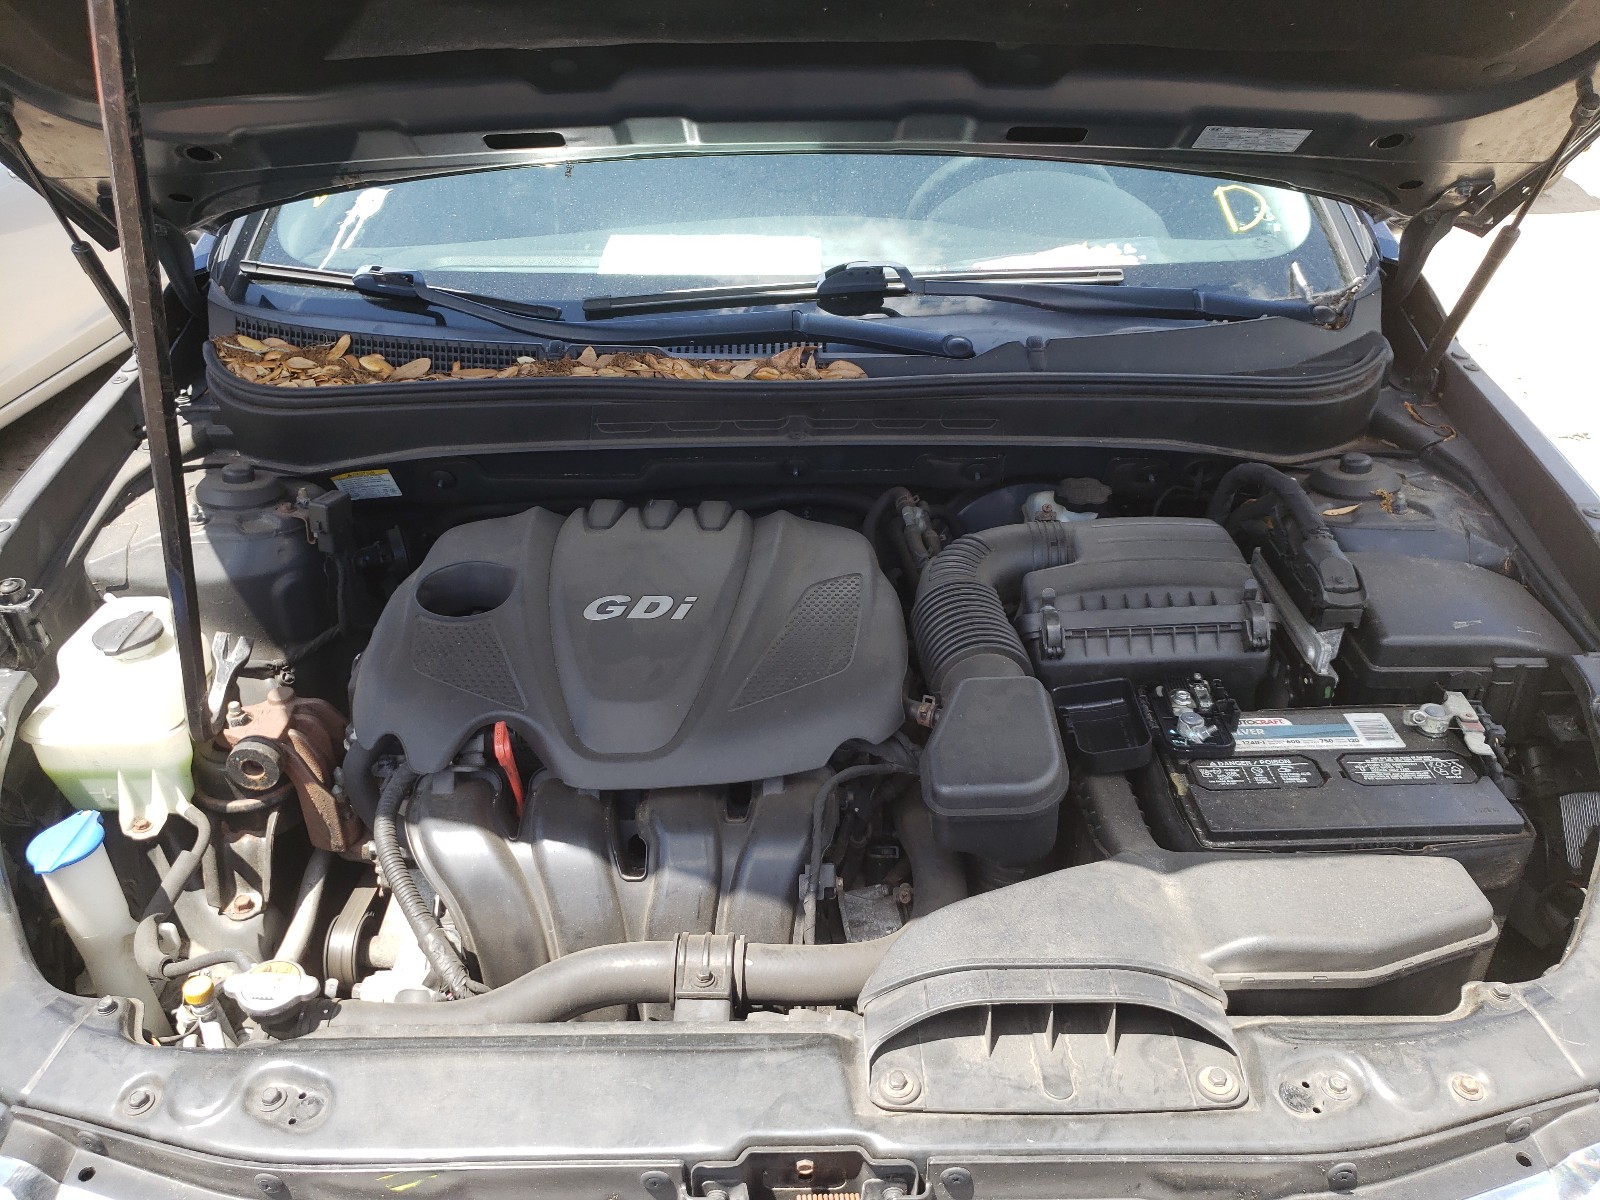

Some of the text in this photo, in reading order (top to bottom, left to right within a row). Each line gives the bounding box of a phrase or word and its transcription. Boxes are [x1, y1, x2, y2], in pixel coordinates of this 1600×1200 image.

[1214, 184, 1267, 233] D
[583, 595, 699, 621] GDi
[1232, 728, 1265, 736] LVER
